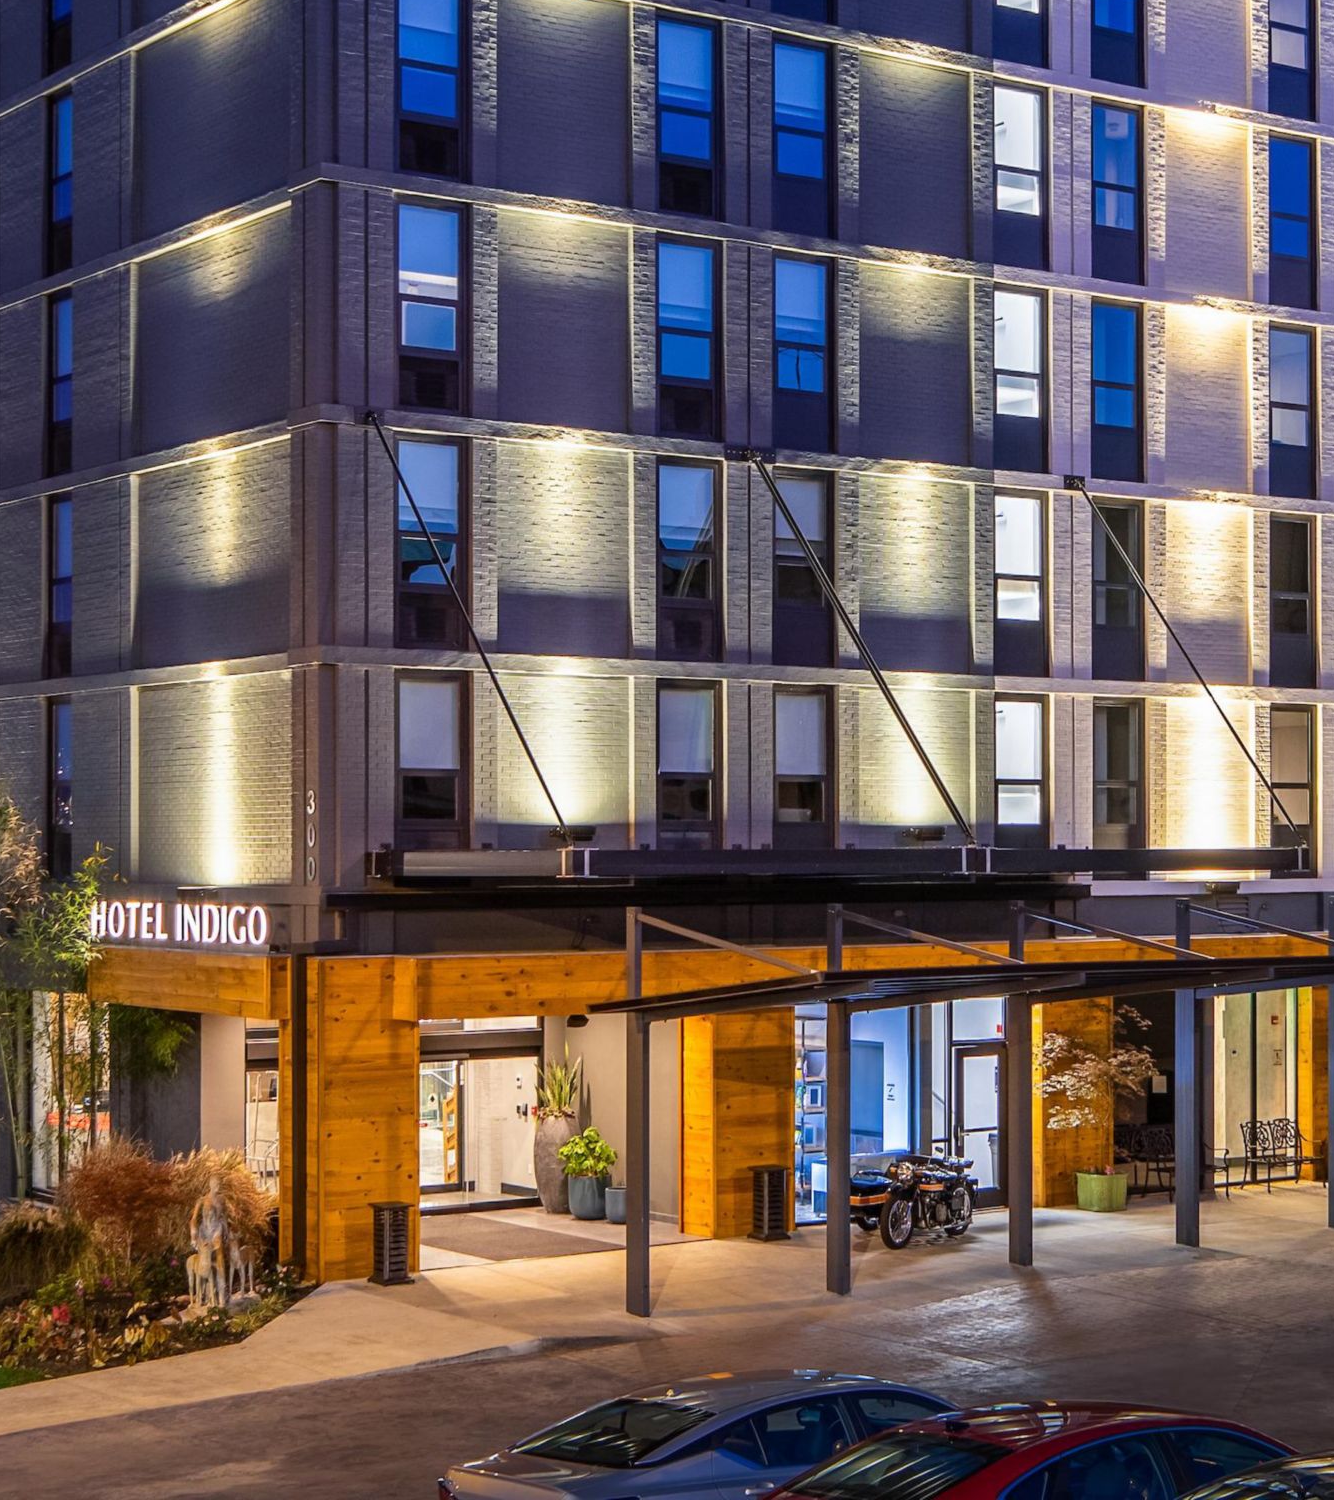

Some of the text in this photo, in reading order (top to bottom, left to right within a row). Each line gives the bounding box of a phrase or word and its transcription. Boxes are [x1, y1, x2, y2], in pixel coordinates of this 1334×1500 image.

[306, 789, 316, 881] 300
[91, 901, 267, 945] HOTEL INDIGO
